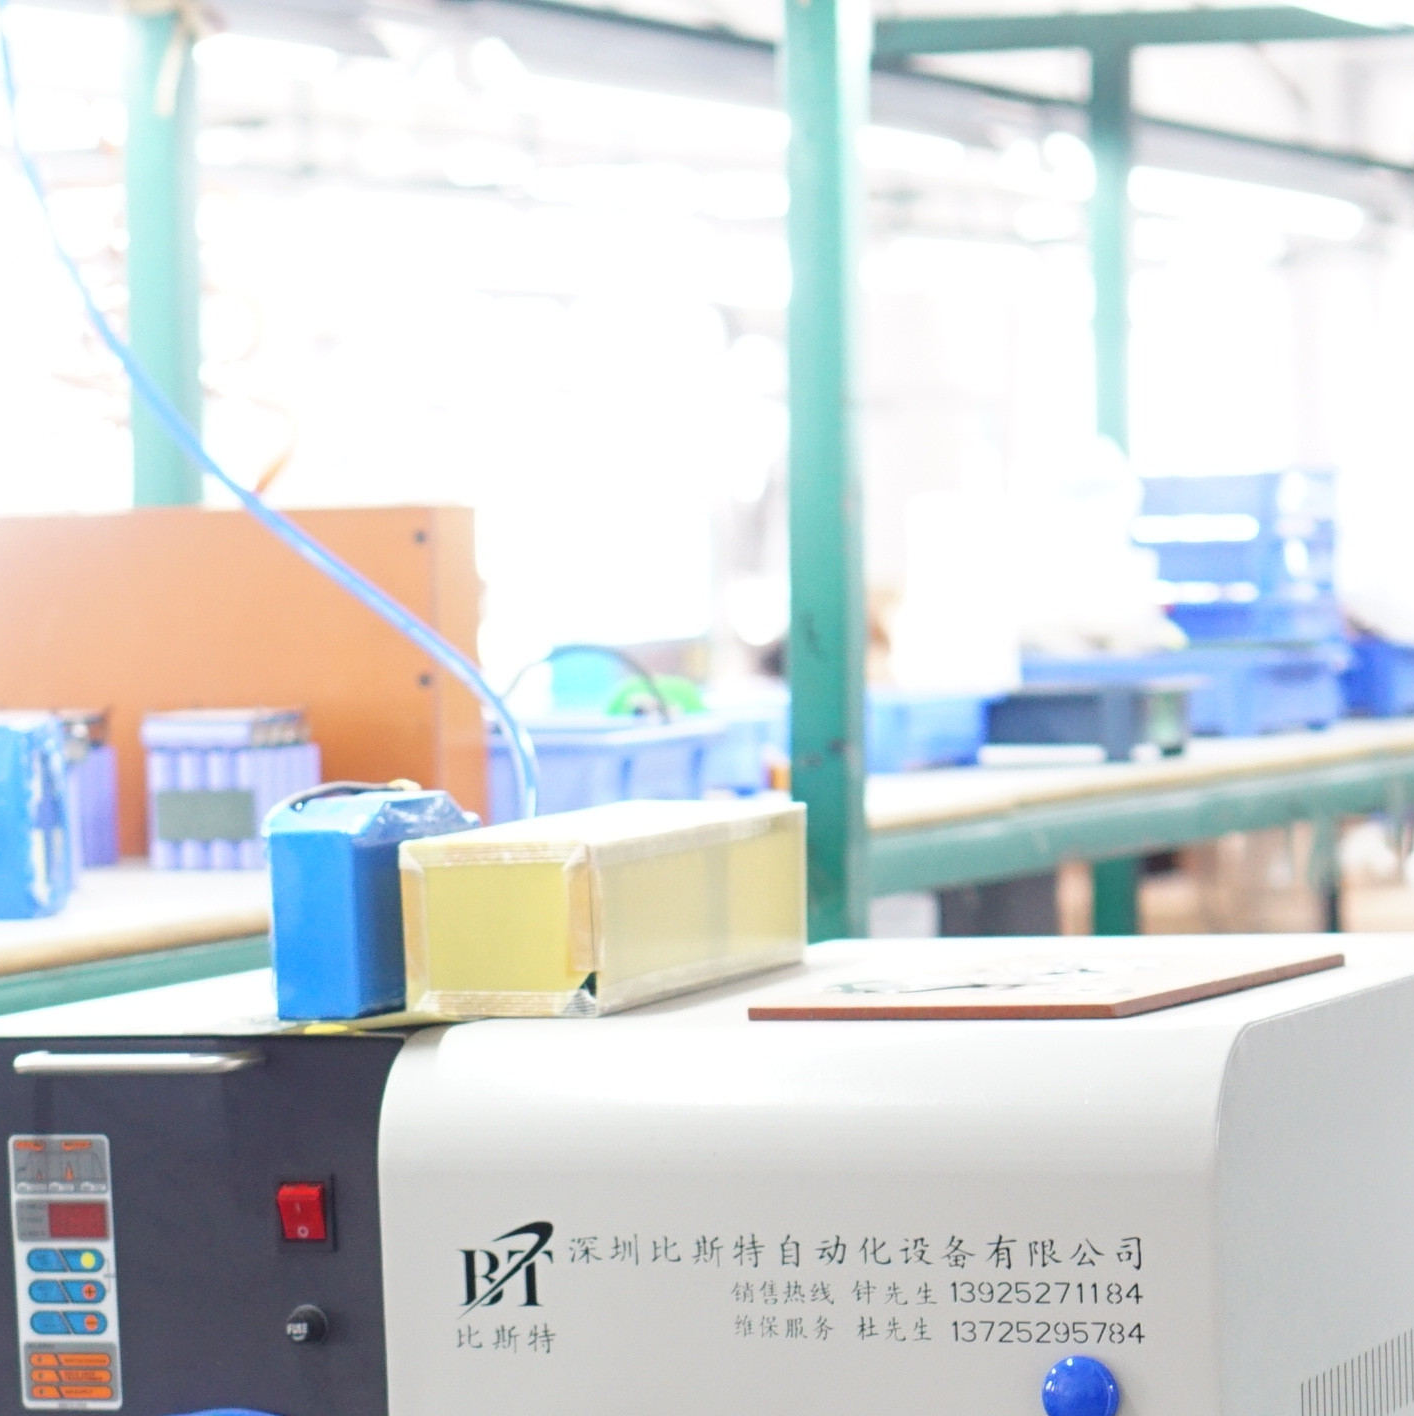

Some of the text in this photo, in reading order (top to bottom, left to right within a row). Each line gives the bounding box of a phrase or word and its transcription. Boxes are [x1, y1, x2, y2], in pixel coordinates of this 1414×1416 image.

[568, 1232, 1143, 1272] 深圳比斯特自动化设备有限公司
[730, 1279, 1144, 1306] 销售热线 钟先生 13925271184
[456, 1322, 556, 1354] 比斯特
[733, 1314, 1147, 1344] 维保服务 杜先生 13725295784
